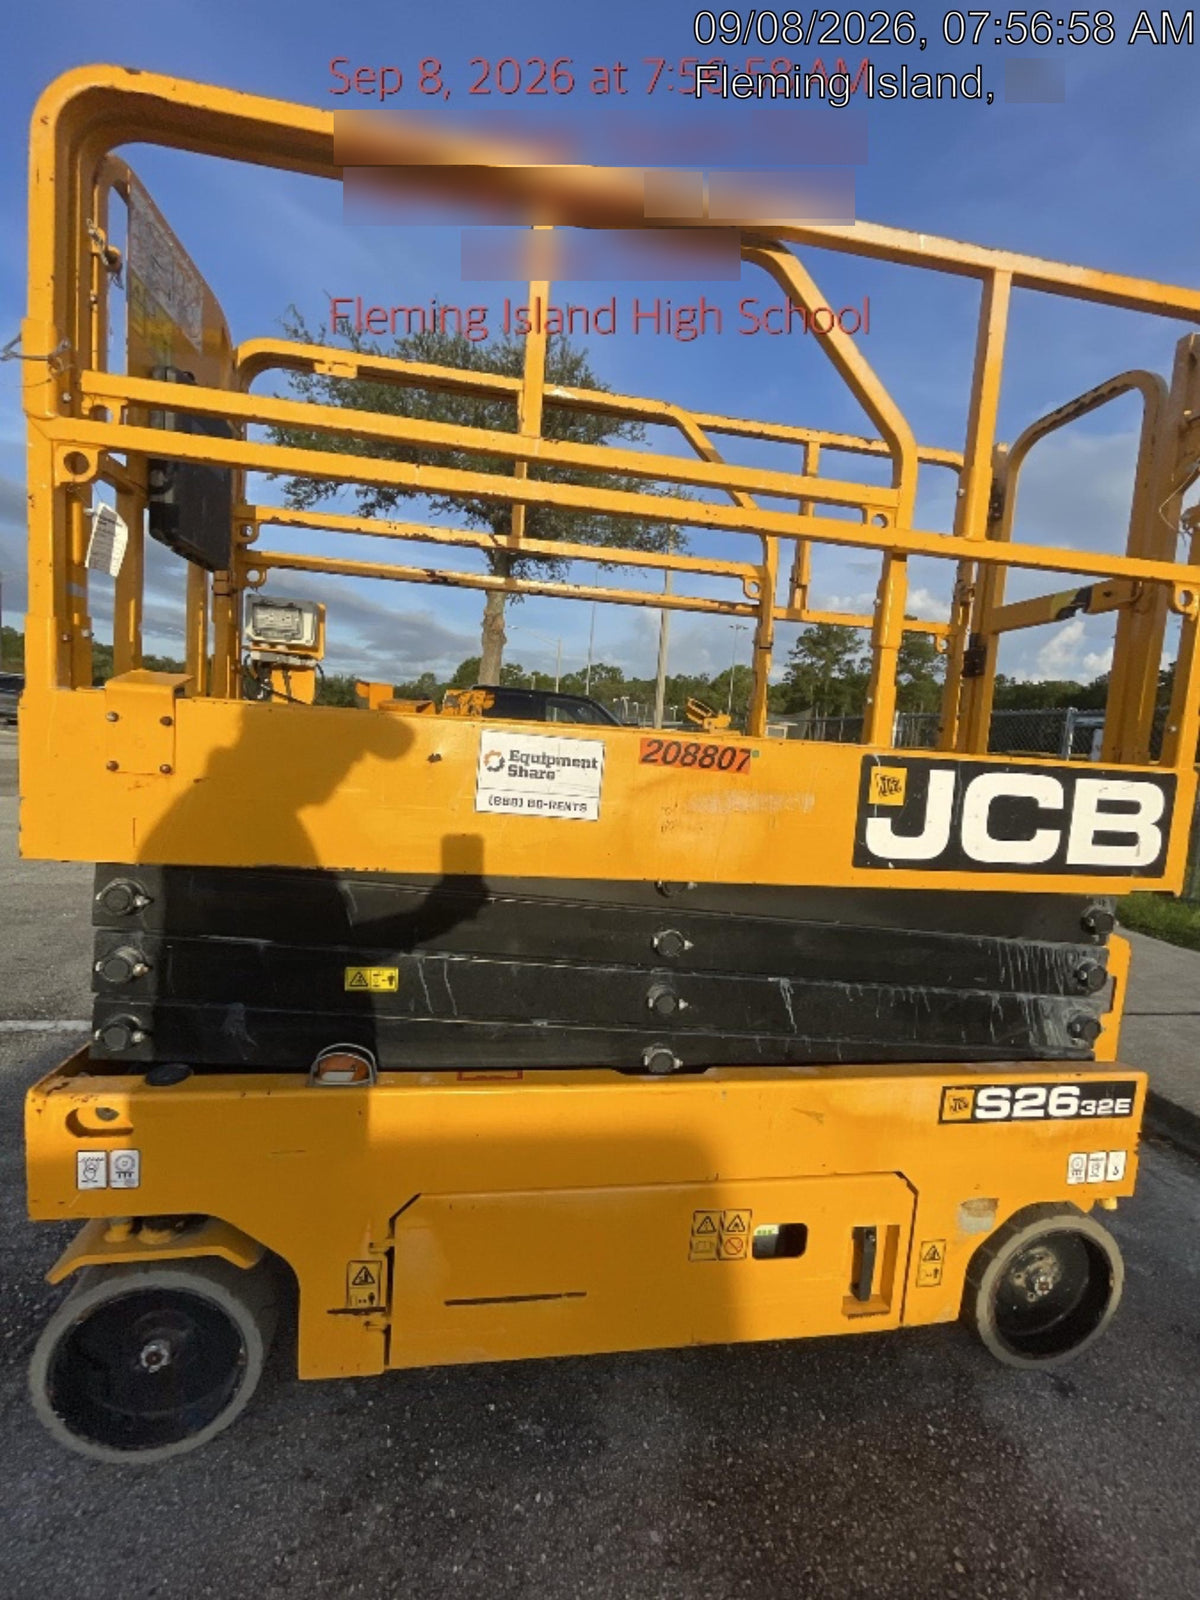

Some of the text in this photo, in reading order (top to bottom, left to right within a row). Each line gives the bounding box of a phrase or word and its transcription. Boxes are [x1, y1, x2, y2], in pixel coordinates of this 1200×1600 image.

[507, 764, 556, 781] Share
[508, 749, 599, 770] Equipment
[641, 739, 752, 773] 208807
[866, 769, 1166, 866] JCB
[975, 1085, 1081, 1119] S26
[1080, 1098, 1133, 1116] 32E
